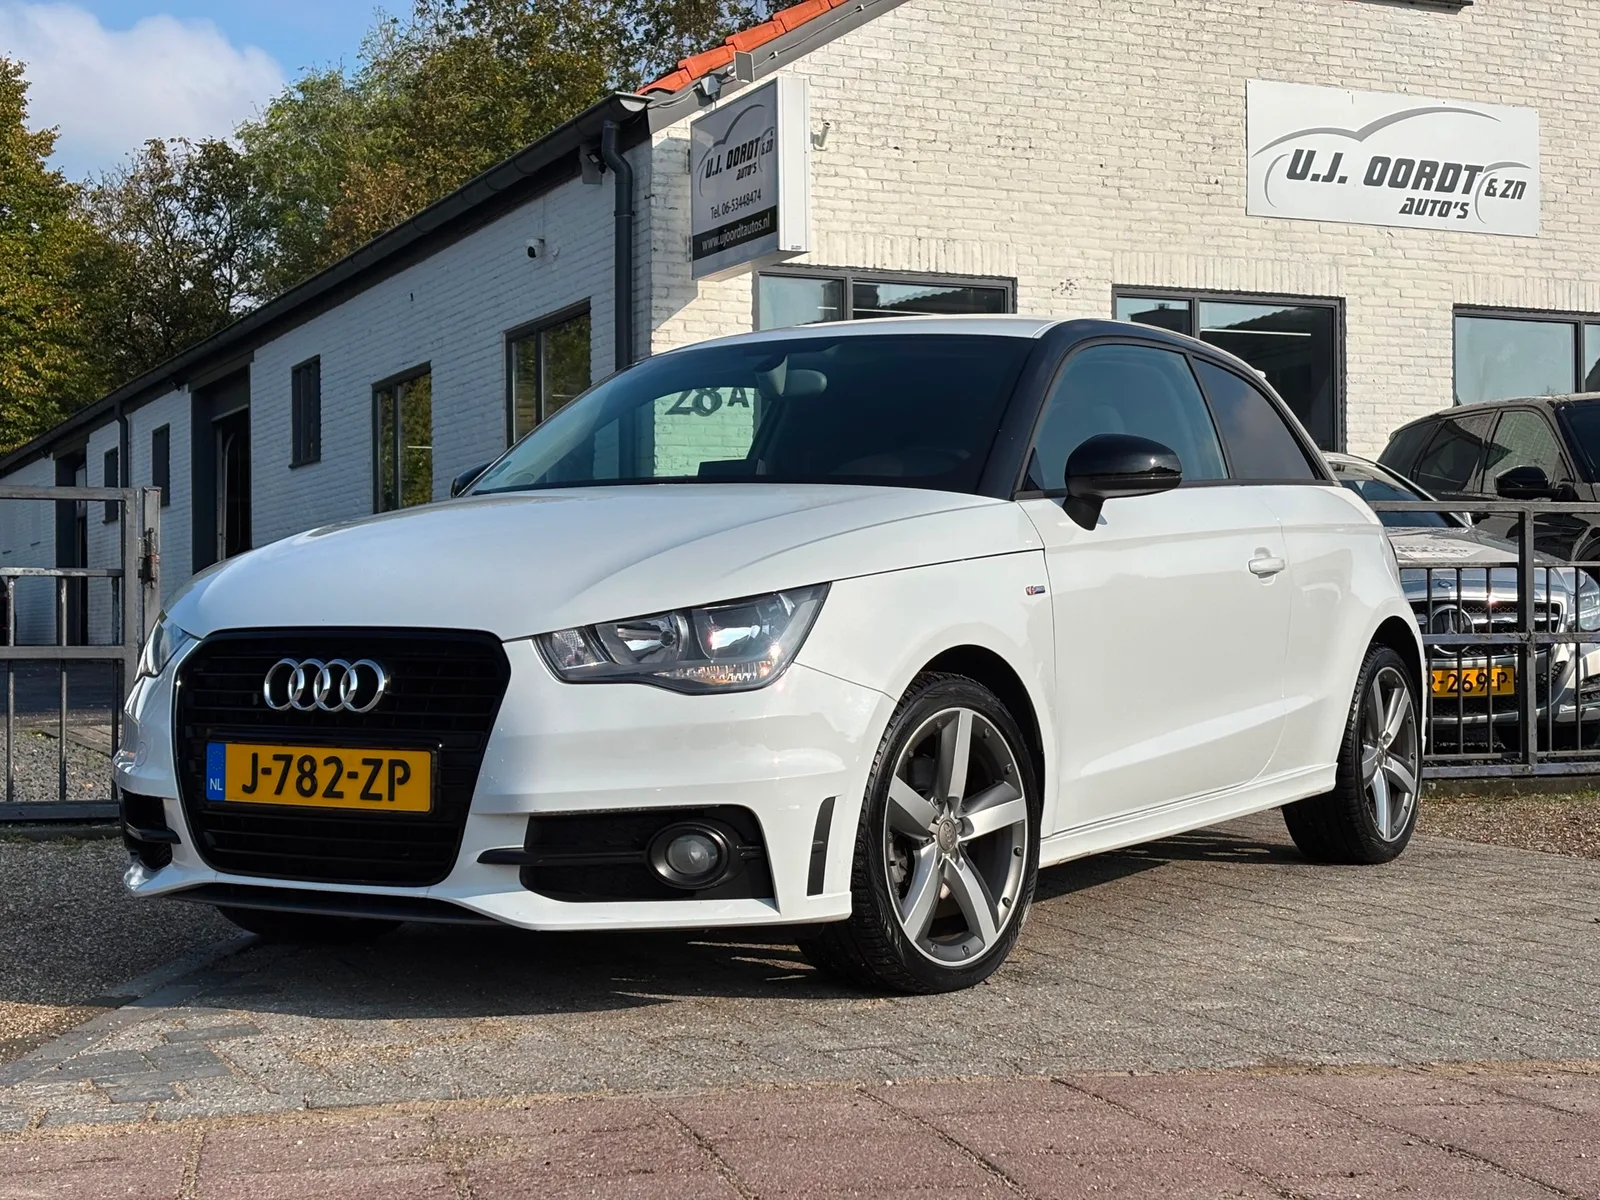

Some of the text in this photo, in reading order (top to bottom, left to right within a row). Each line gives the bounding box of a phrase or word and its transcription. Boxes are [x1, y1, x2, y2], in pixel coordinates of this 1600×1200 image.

[705, 154, 723, 179] U.J.
[726, 136, 761, 170] OORDT
[1286, 148, 1348, 184] U.J.
[1363, 155, 1485, 195] OORDT
[710, 188, 762, 220] Tel. 06-53448474
[1398, 197, 1470, 219] AUTO'S
[701, 212, 771, 251] www.ujoordtautos.nl
[209, 777, 224, 791] NL
[241, 752, 411, 802] J-782-ZP
